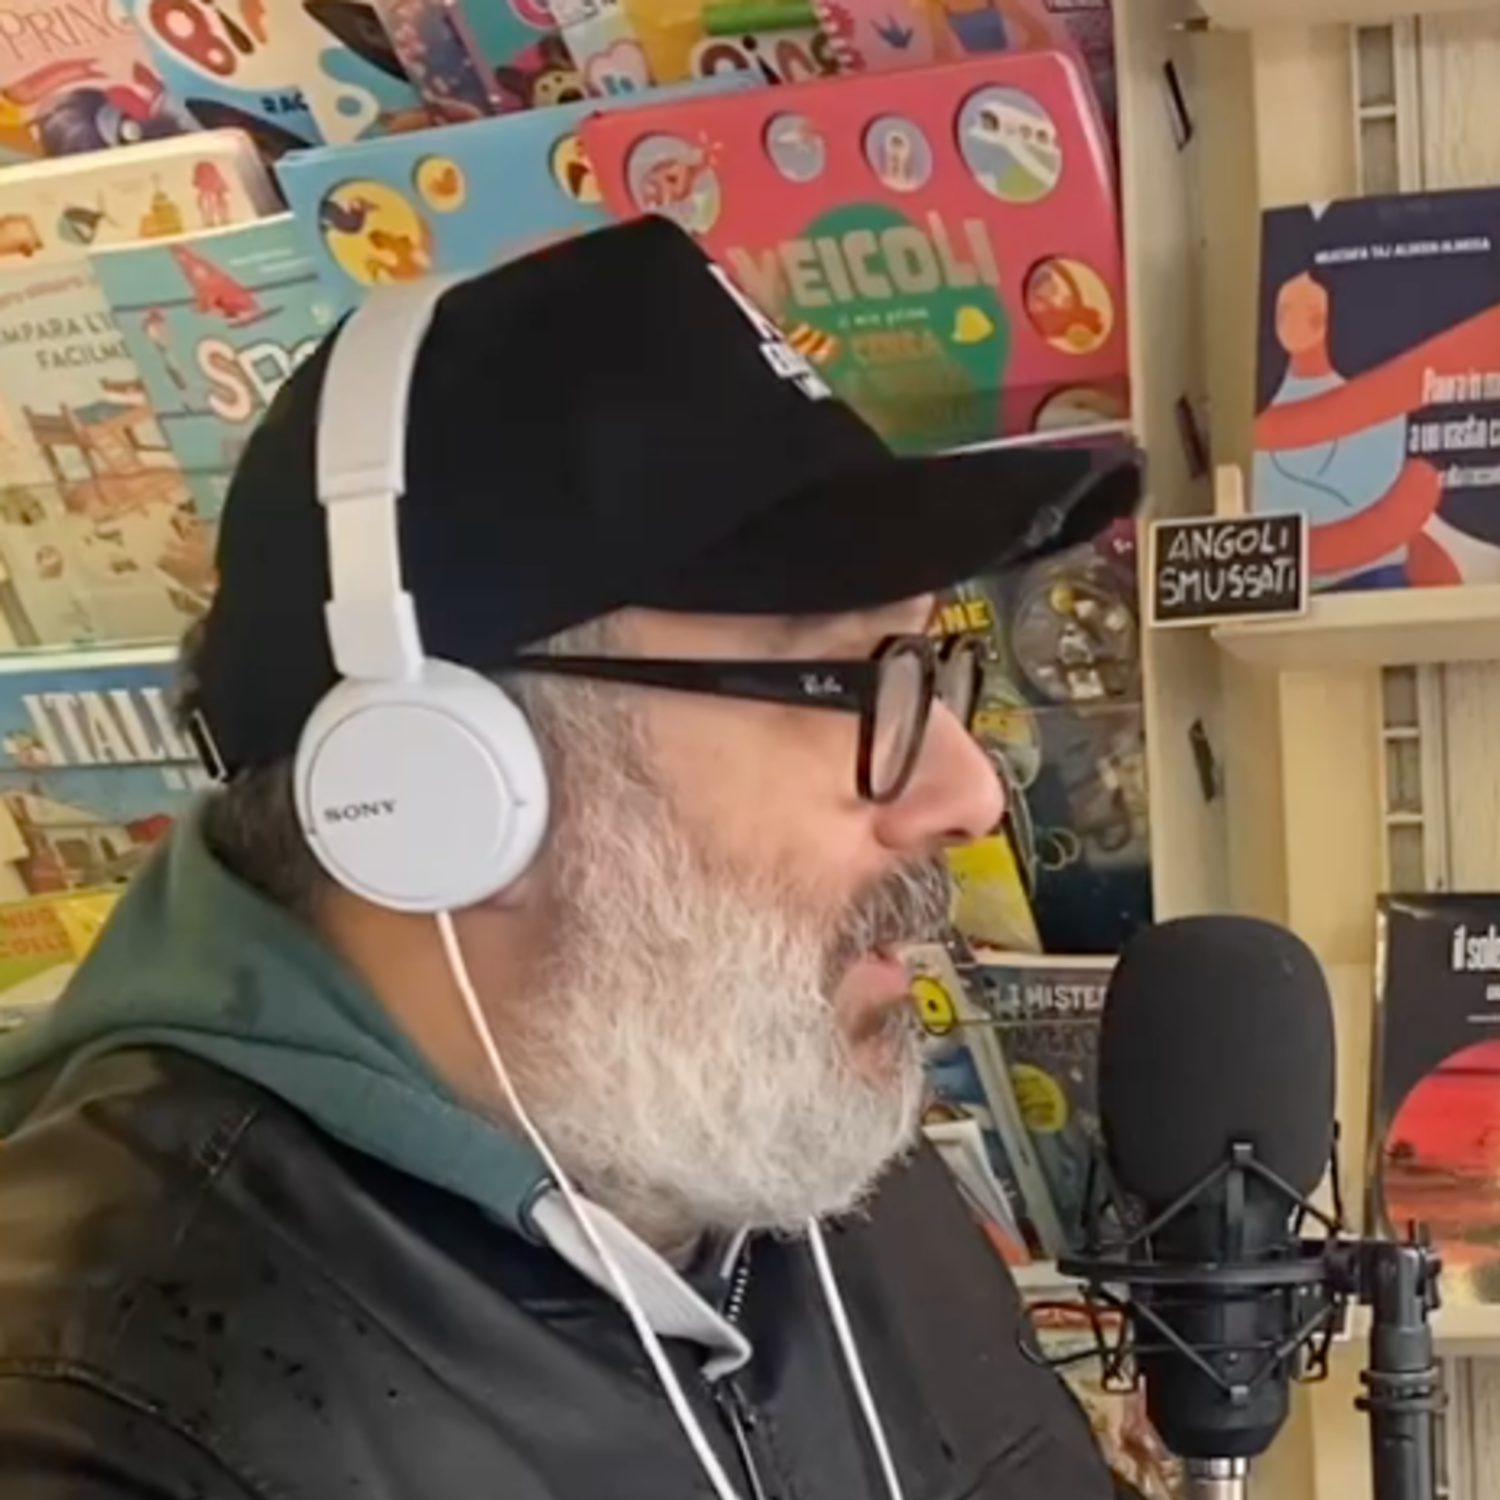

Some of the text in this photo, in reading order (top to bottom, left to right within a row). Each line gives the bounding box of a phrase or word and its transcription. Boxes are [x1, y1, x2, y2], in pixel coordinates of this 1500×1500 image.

[726, 210, 1001, 314] VEICOLI
[1168, 522, 1289, 562] ANGOLI
[1160, 556, 1296, 607] SMUSSATI
[323, 799, 397, 825] SONY
